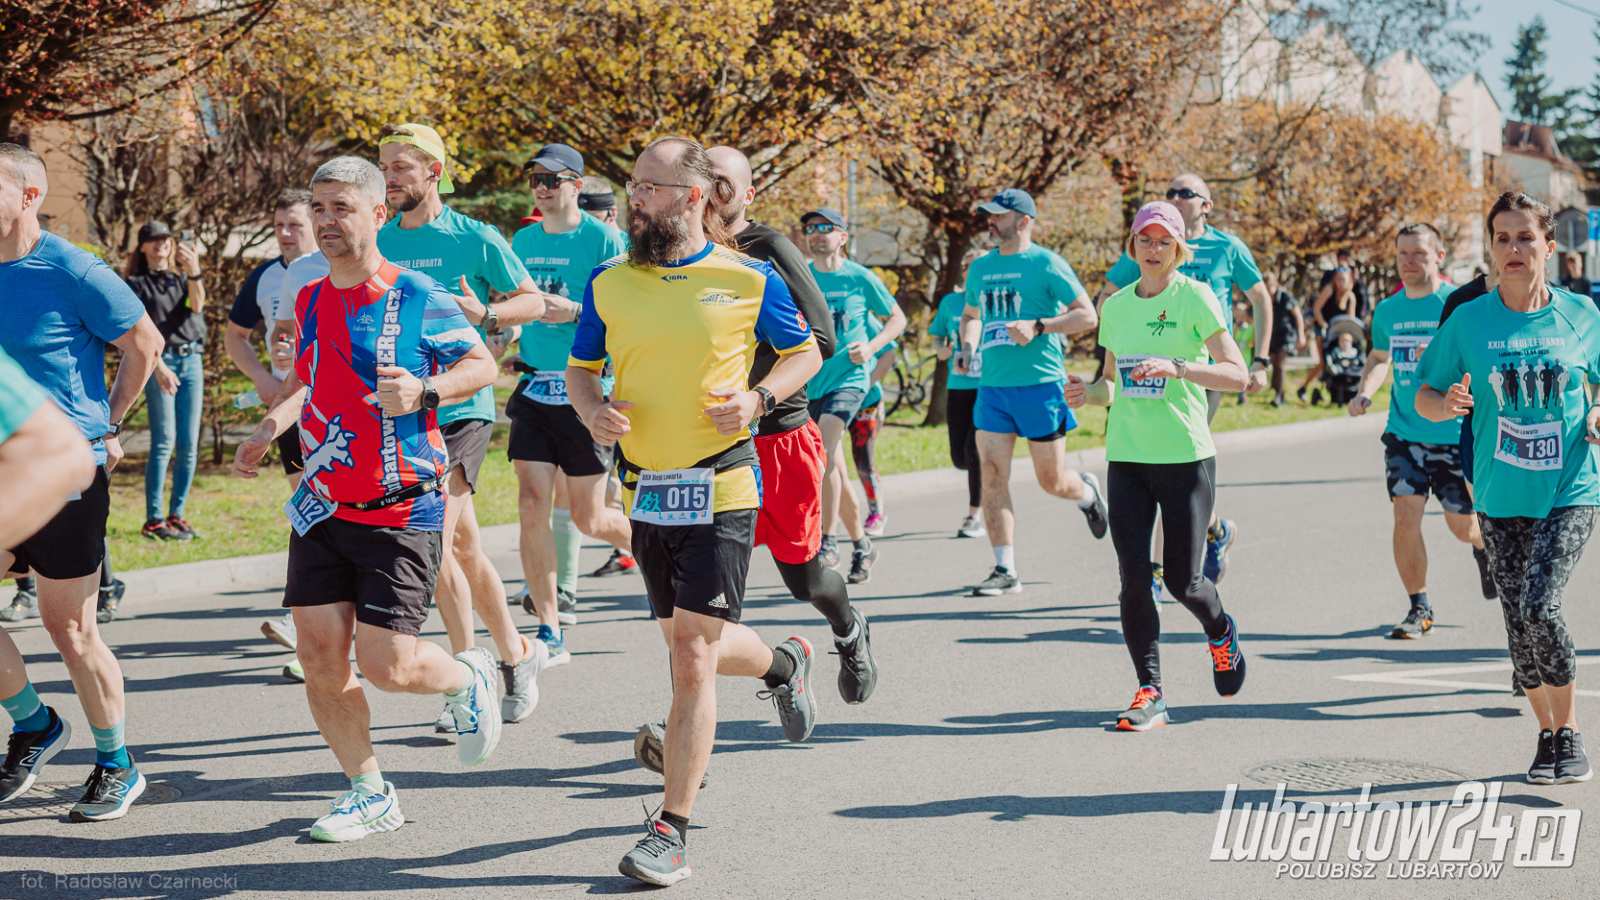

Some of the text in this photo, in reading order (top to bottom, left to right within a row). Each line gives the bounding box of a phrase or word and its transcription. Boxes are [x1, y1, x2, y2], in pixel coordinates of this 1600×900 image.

[1526, 438, 1556, 458] 130
[299, 493, 324, 522] 012
[667, 486, 706, 509] 015
